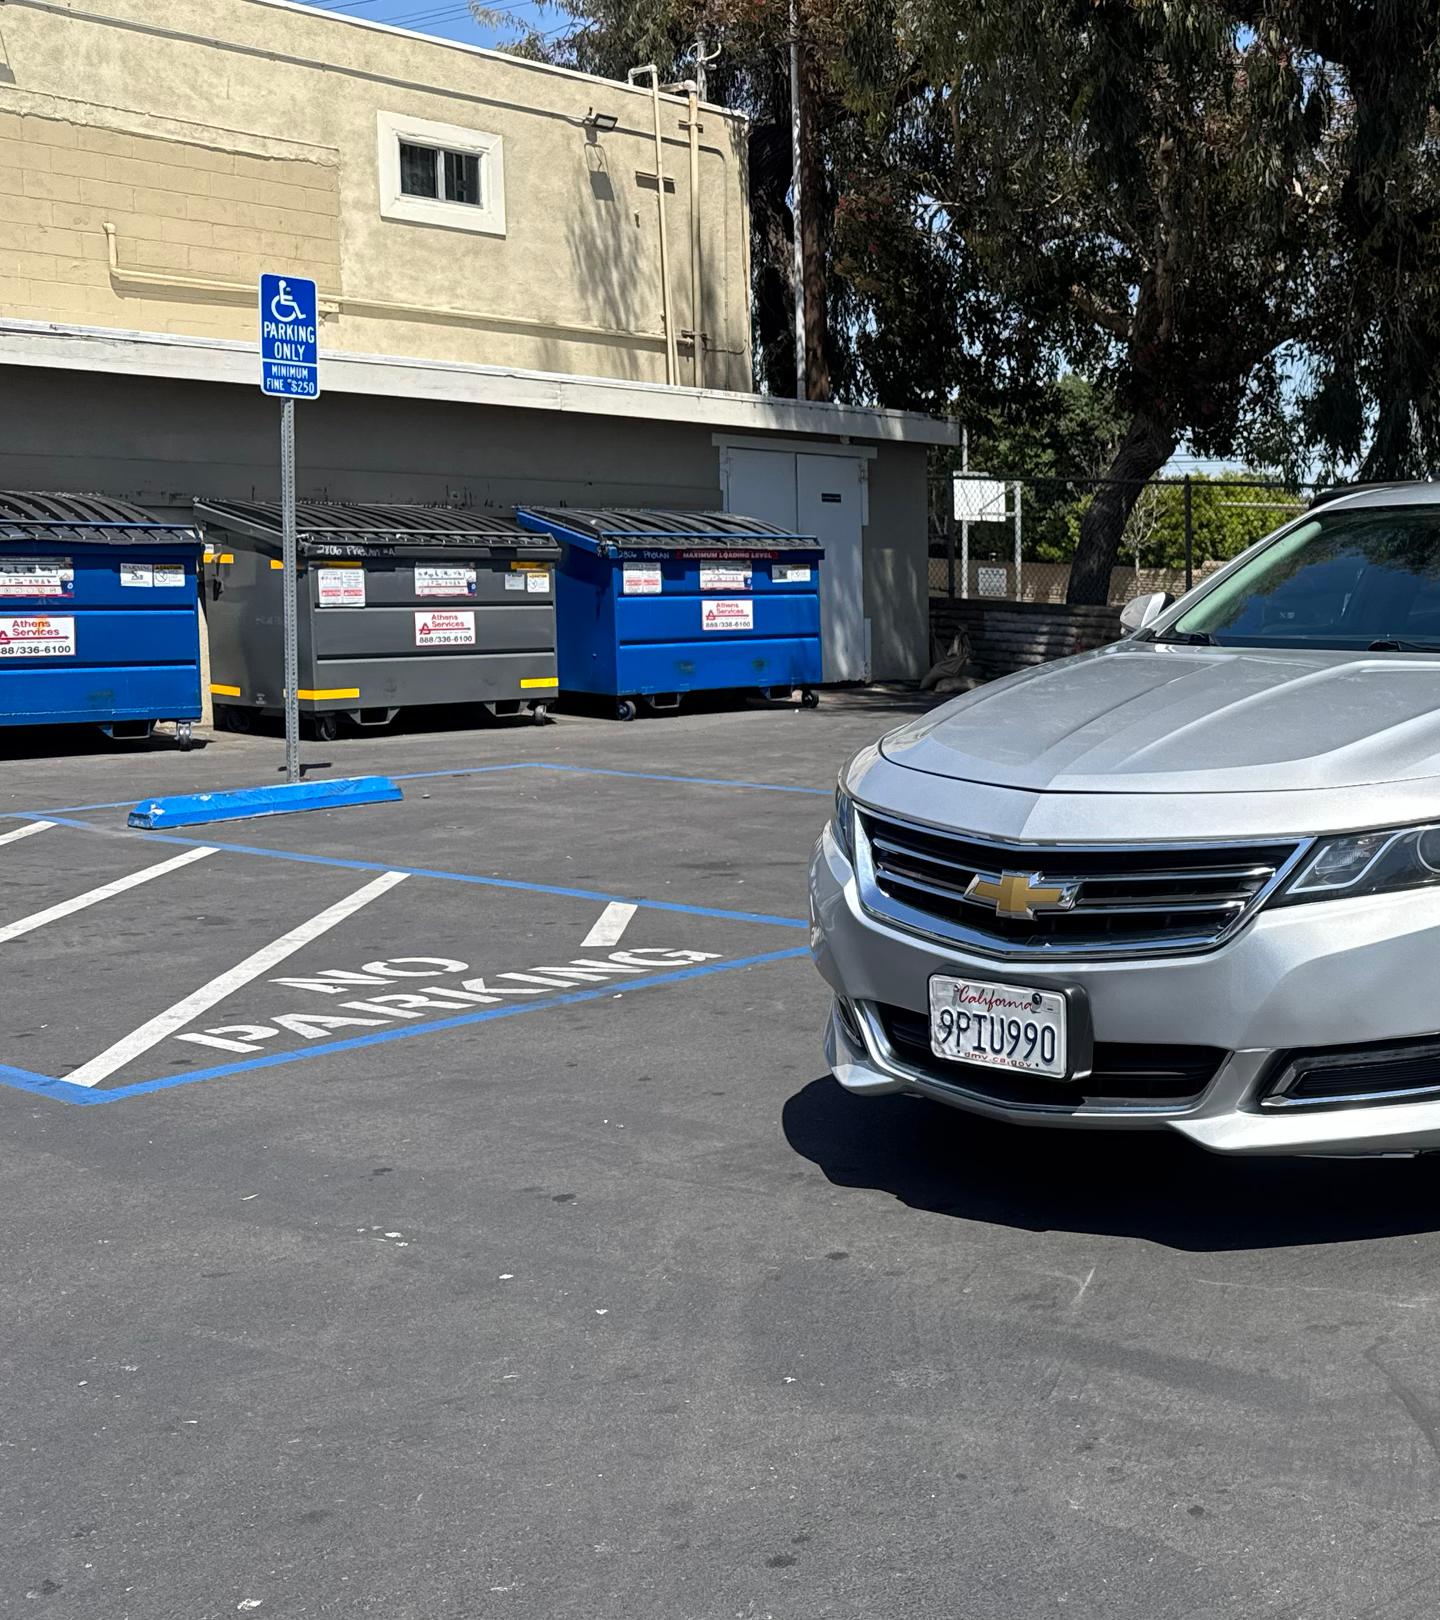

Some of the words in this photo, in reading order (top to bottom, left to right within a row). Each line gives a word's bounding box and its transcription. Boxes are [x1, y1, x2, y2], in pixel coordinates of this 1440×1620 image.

[264, 321, 315, 343] PARKING
[274, 341, 305, 361] ONLY
[271, 364, 308, 379] MINIMUM
[266, 377, 285, 391] FINE
[290, 380, 315, 394] $250
[719, 551, 749, 559] LOADING
[751, 551, 772, 559] LEVEL
[12, 619, 51, 628] Athens
[12, 627, 60, 636] Services
[431, 620, 465, 628] Services
[267, 957, 469, 994] NO
[175, 948, 723, 1054] PARKING
[958, 984, 1033, 1013] California
[939, 1008, 1056, 1064] 9PIU990
[964, 1051, 1033, 1069] dmv.ca.gov
